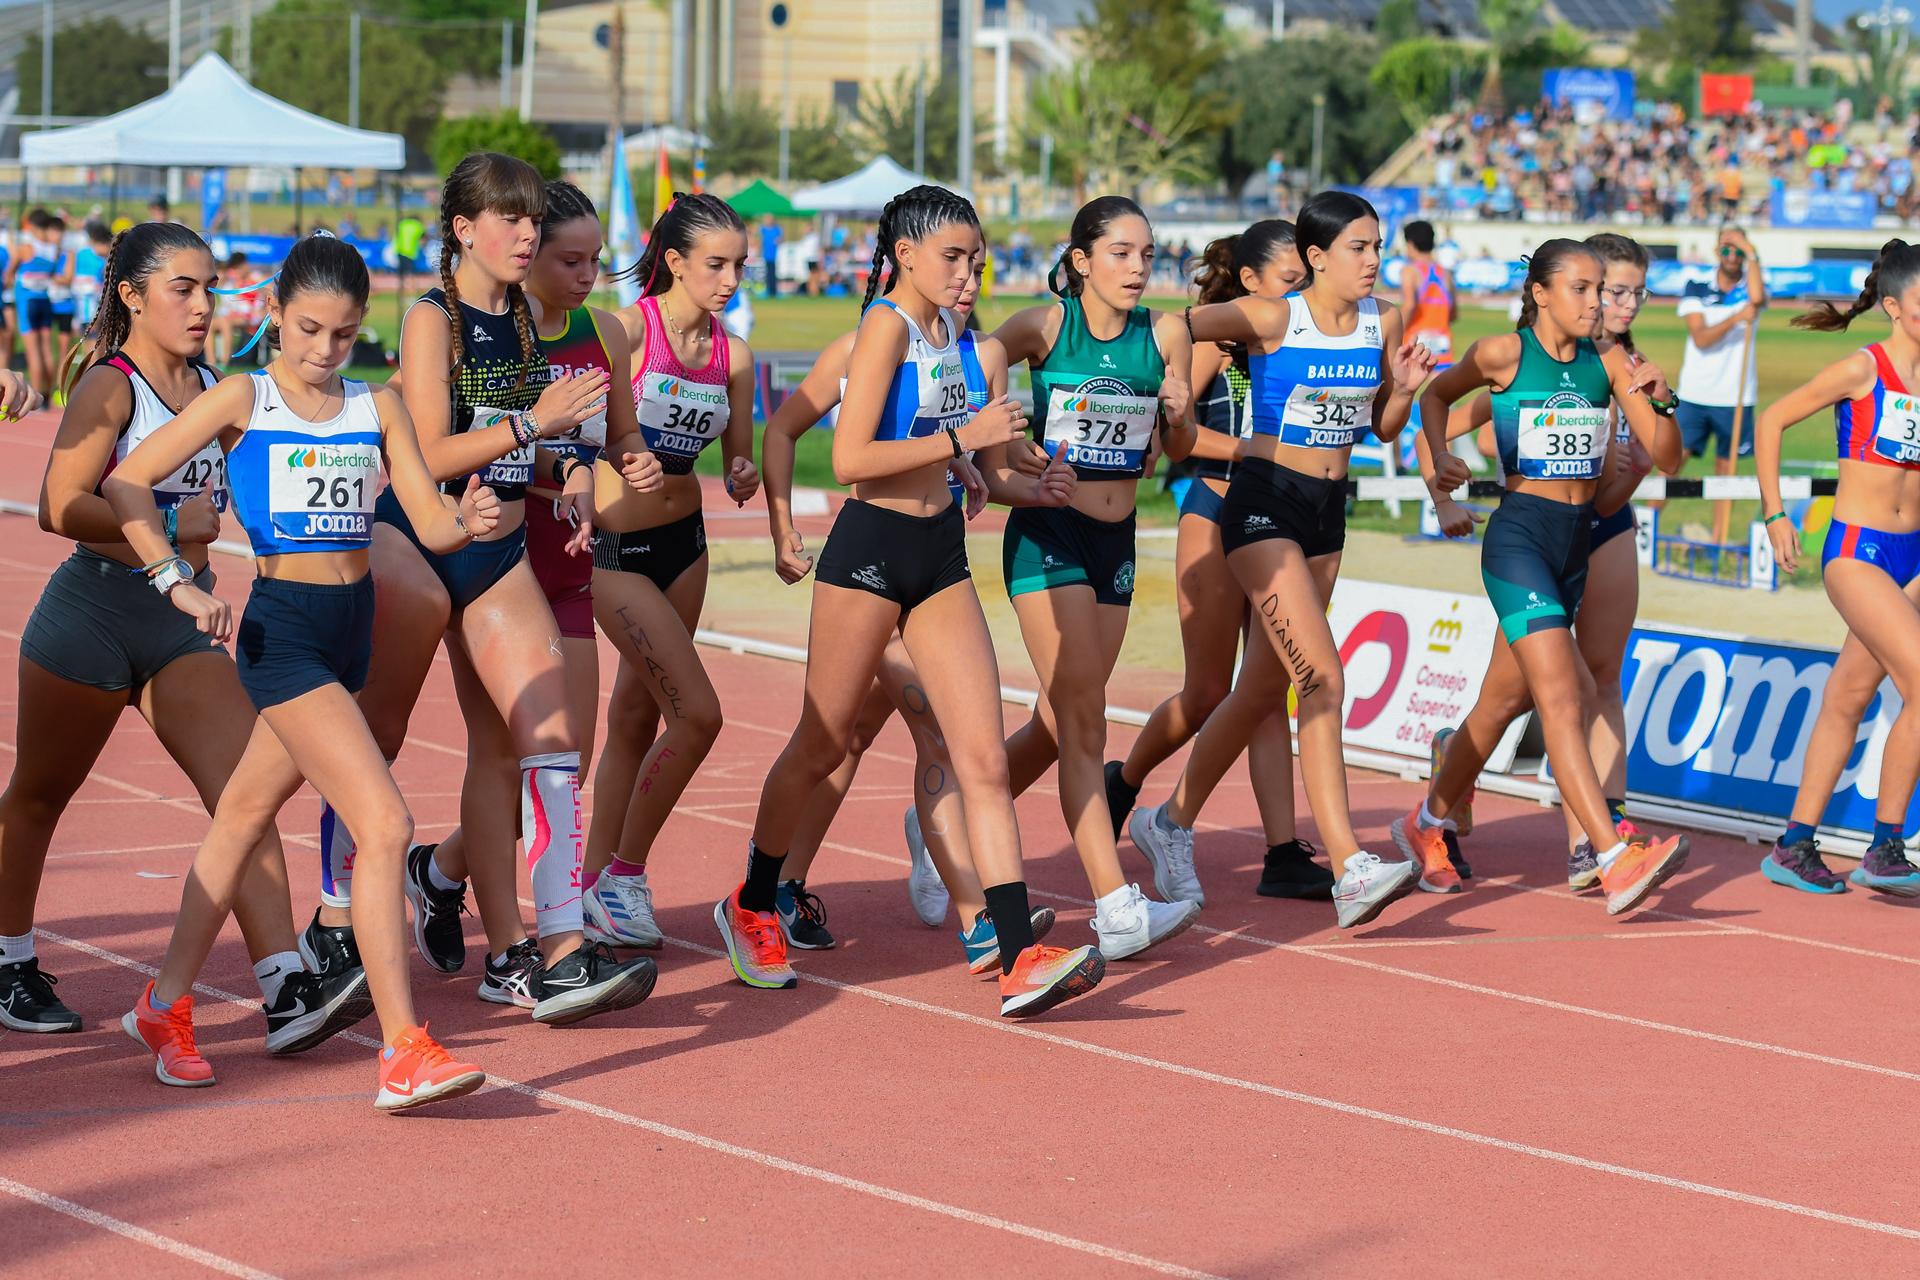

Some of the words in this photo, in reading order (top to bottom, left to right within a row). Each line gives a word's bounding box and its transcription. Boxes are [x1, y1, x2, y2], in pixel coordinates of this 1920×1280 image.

[679, 385, 726, 405] Iberdrola
[940, 382, 966, 414] 259
[1089, 401, 1146, 415] Iberdrola
[1312, 404, 1357, 426] 342
[663, 404, 714, 435] 346
[1557, 415, 1605, 427] Iberdrola
[1903, 418, 1920, 443] 3
[653, 432, 703, 453] Joma
[1075, 418, 1127, 446] 378
[1305, 429, 1354, 445] Joma
[1545, 433, 1592, 455] 383
[319, 452, 376, 469] Iberdrola
[1067, 446, 1127, 466] Joma
[181, 458, 224, 489] 421
[484, 465, 529, 483] Joma
[1541, 460, 1592, 477] Joma
[306, 477, 364, 508] 261
[304, 514, 367, 535] Joma
[616, 606, 686, 719] IMAGE
[1416, 664, 1468, 696] Consejo
[1406, 692, 1461, 719] Superior
[1396, 719, 1413, 741] de
